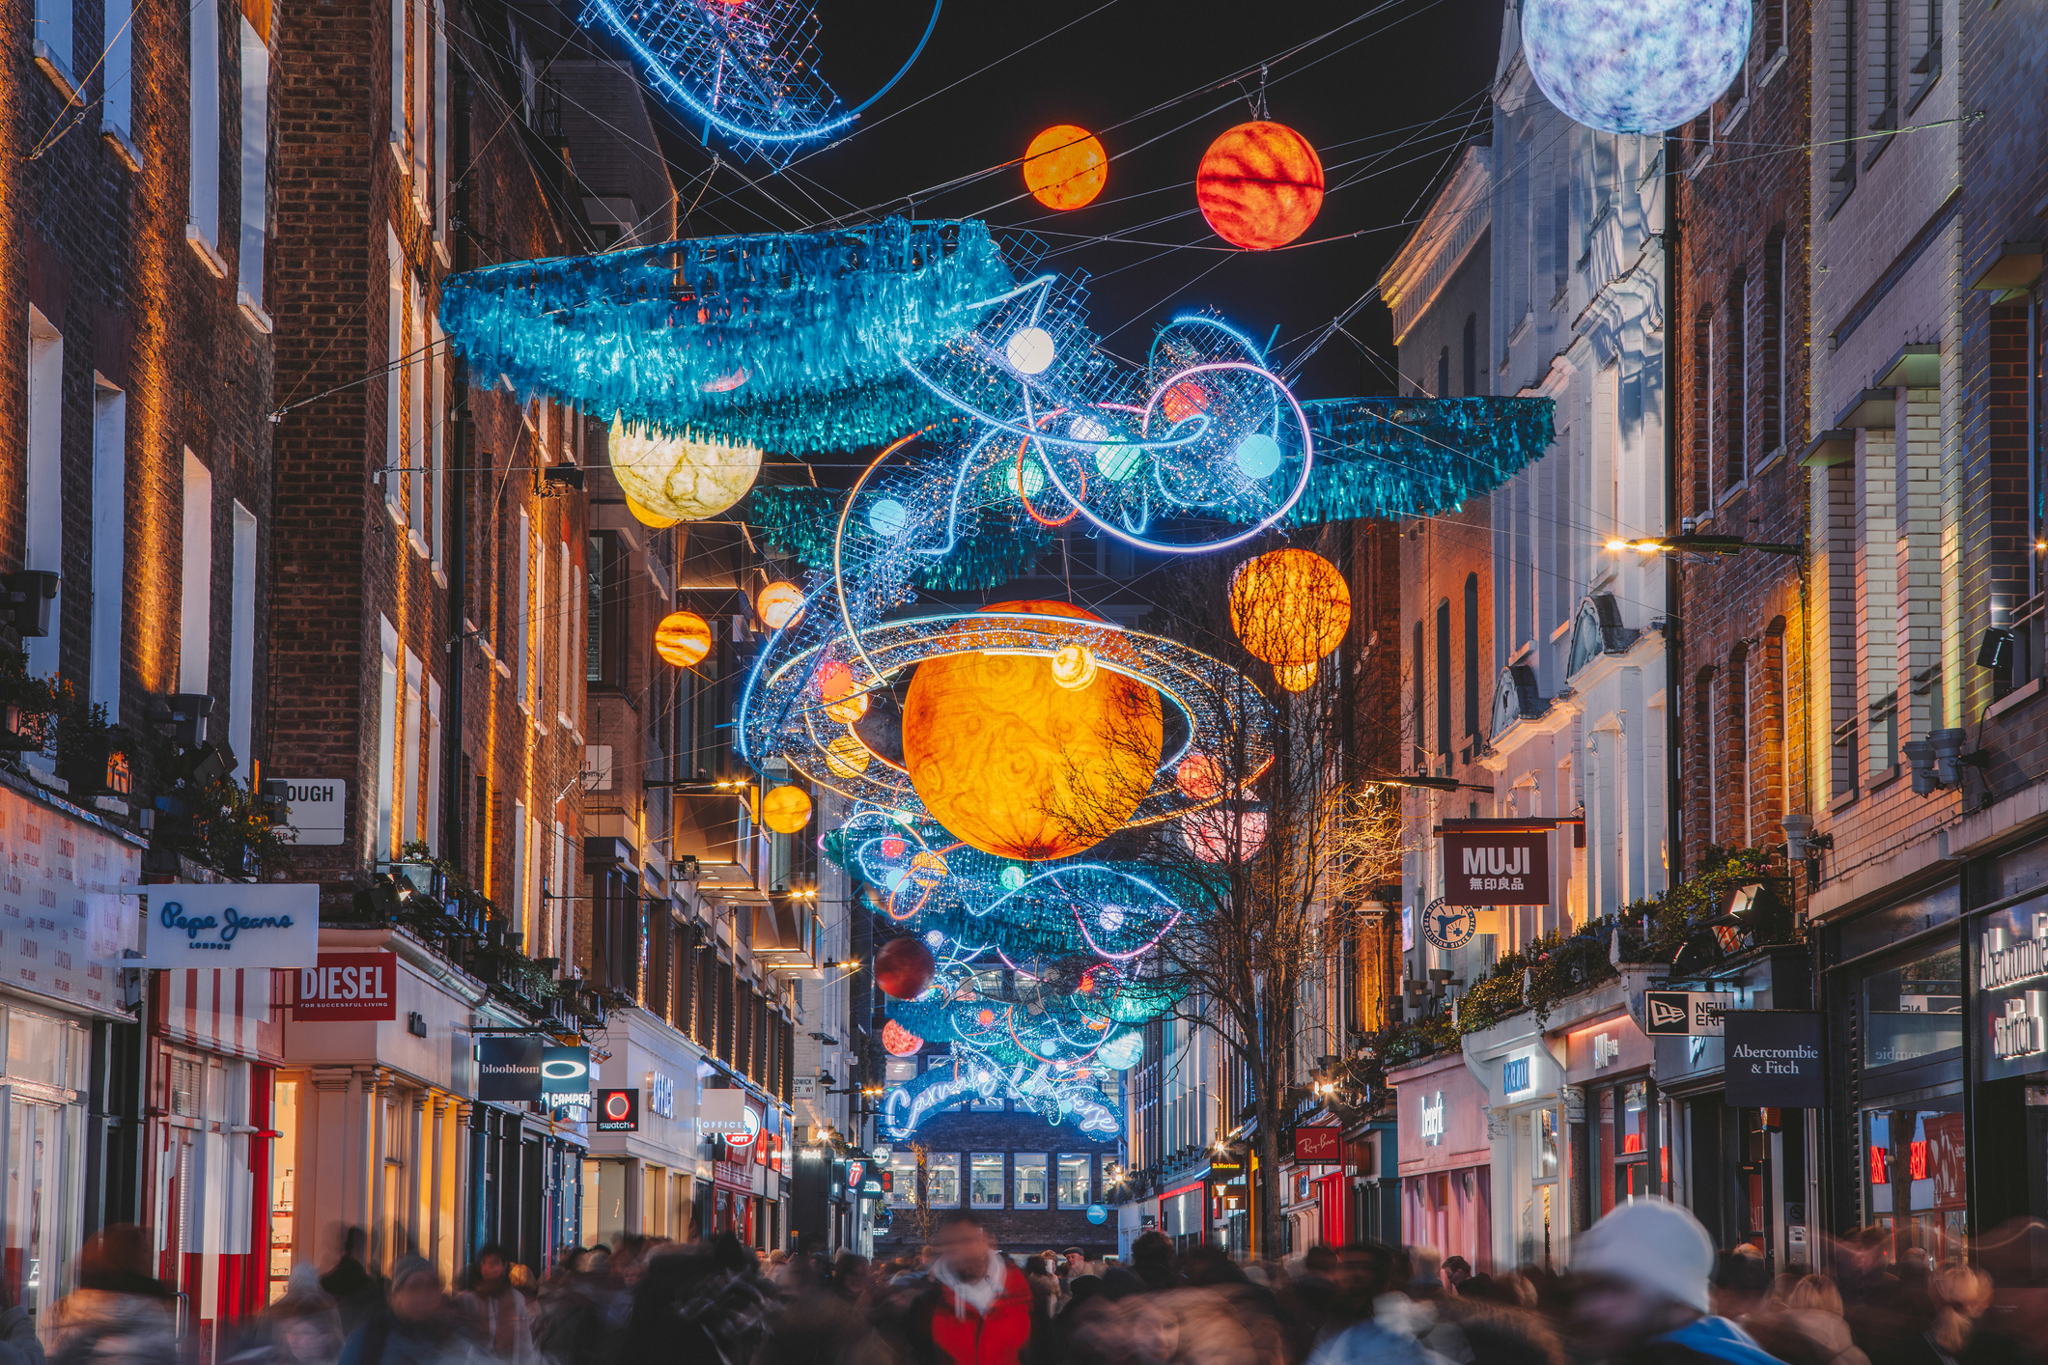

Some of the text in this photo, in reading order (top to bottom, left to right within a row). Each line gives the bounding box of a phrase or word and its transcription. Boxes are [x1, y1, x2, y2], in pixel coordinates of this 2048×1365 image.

[287, 786, 334, 802] OUGH
[1462, 847, 1530, 875] MUJI
[1470, 877, 1524, 891] 無印良品
[161, 901, 294, 942] Pepe Jeans
[189, 942, 231, 950] LONDON
[301, 966, 388, 1000] DIESEL
[1733, 1044, 1818, 1059] Abercrombie
[482, 1064, 539, 1074] bloobloom
[1751, 1060, 1800, 1074] & Fitch
[551, 1093, 591, 1108] CAMPER
[730, 1135, 749, 1143] JOTT
[1298, 1134, 1335, 1153] Ray-Ban
